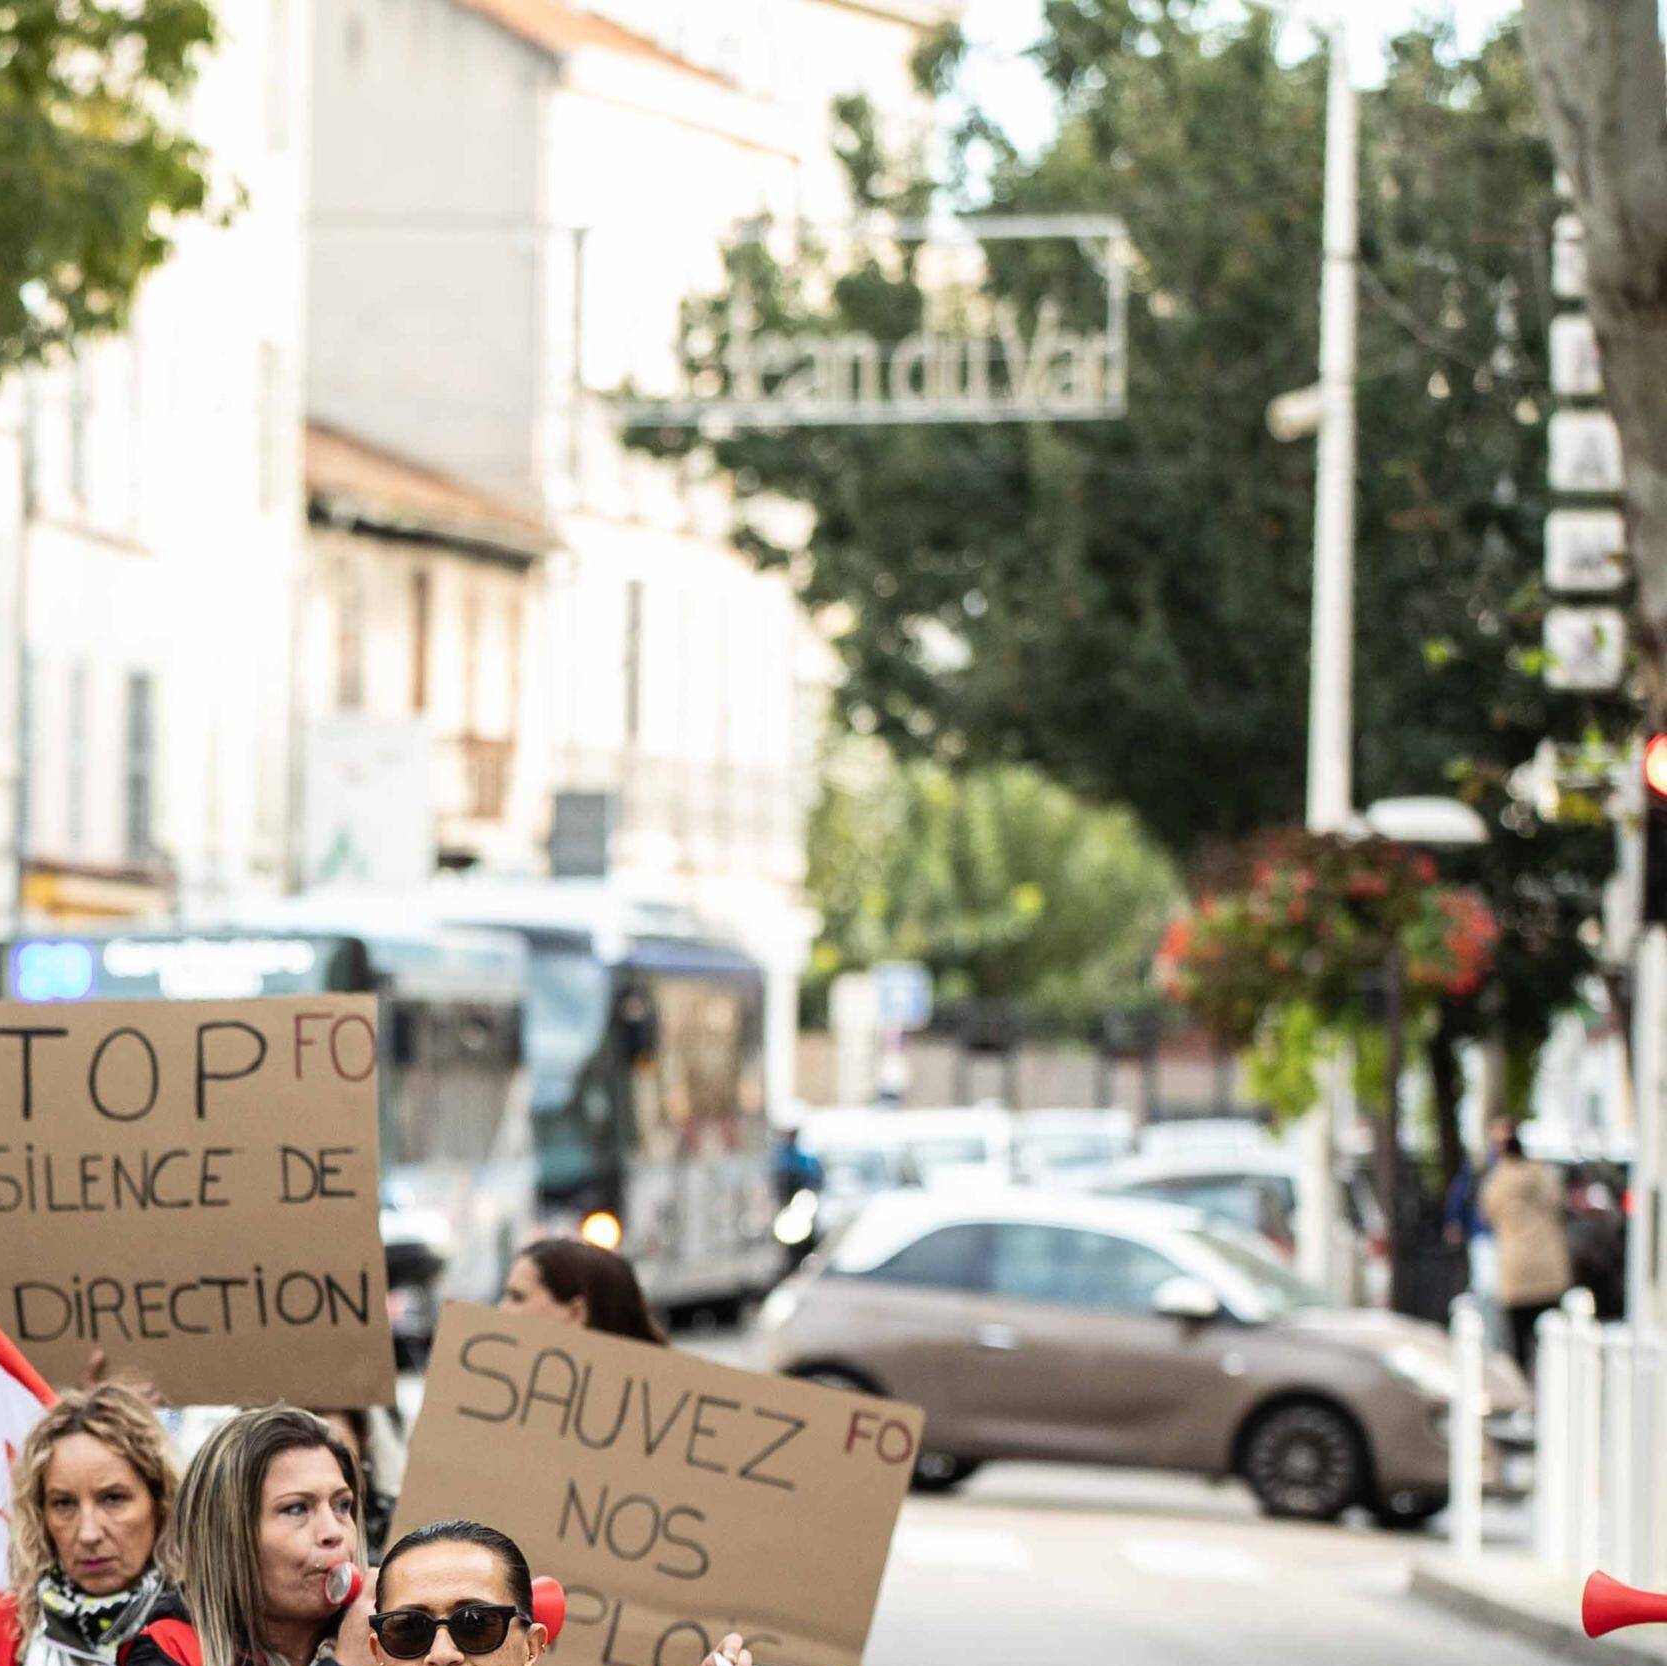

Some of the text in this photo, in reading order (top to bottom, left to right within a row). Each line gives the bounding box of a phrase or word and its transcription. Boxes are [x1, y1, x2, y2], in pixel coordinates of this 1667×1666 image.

[292, 1012, 377, 1082] FO
[279, 1145, 356, 1204] DE
[457, 1332, 915, 1491] SAUVEZ FO
[557, 1477, 710, 1581] NOS
